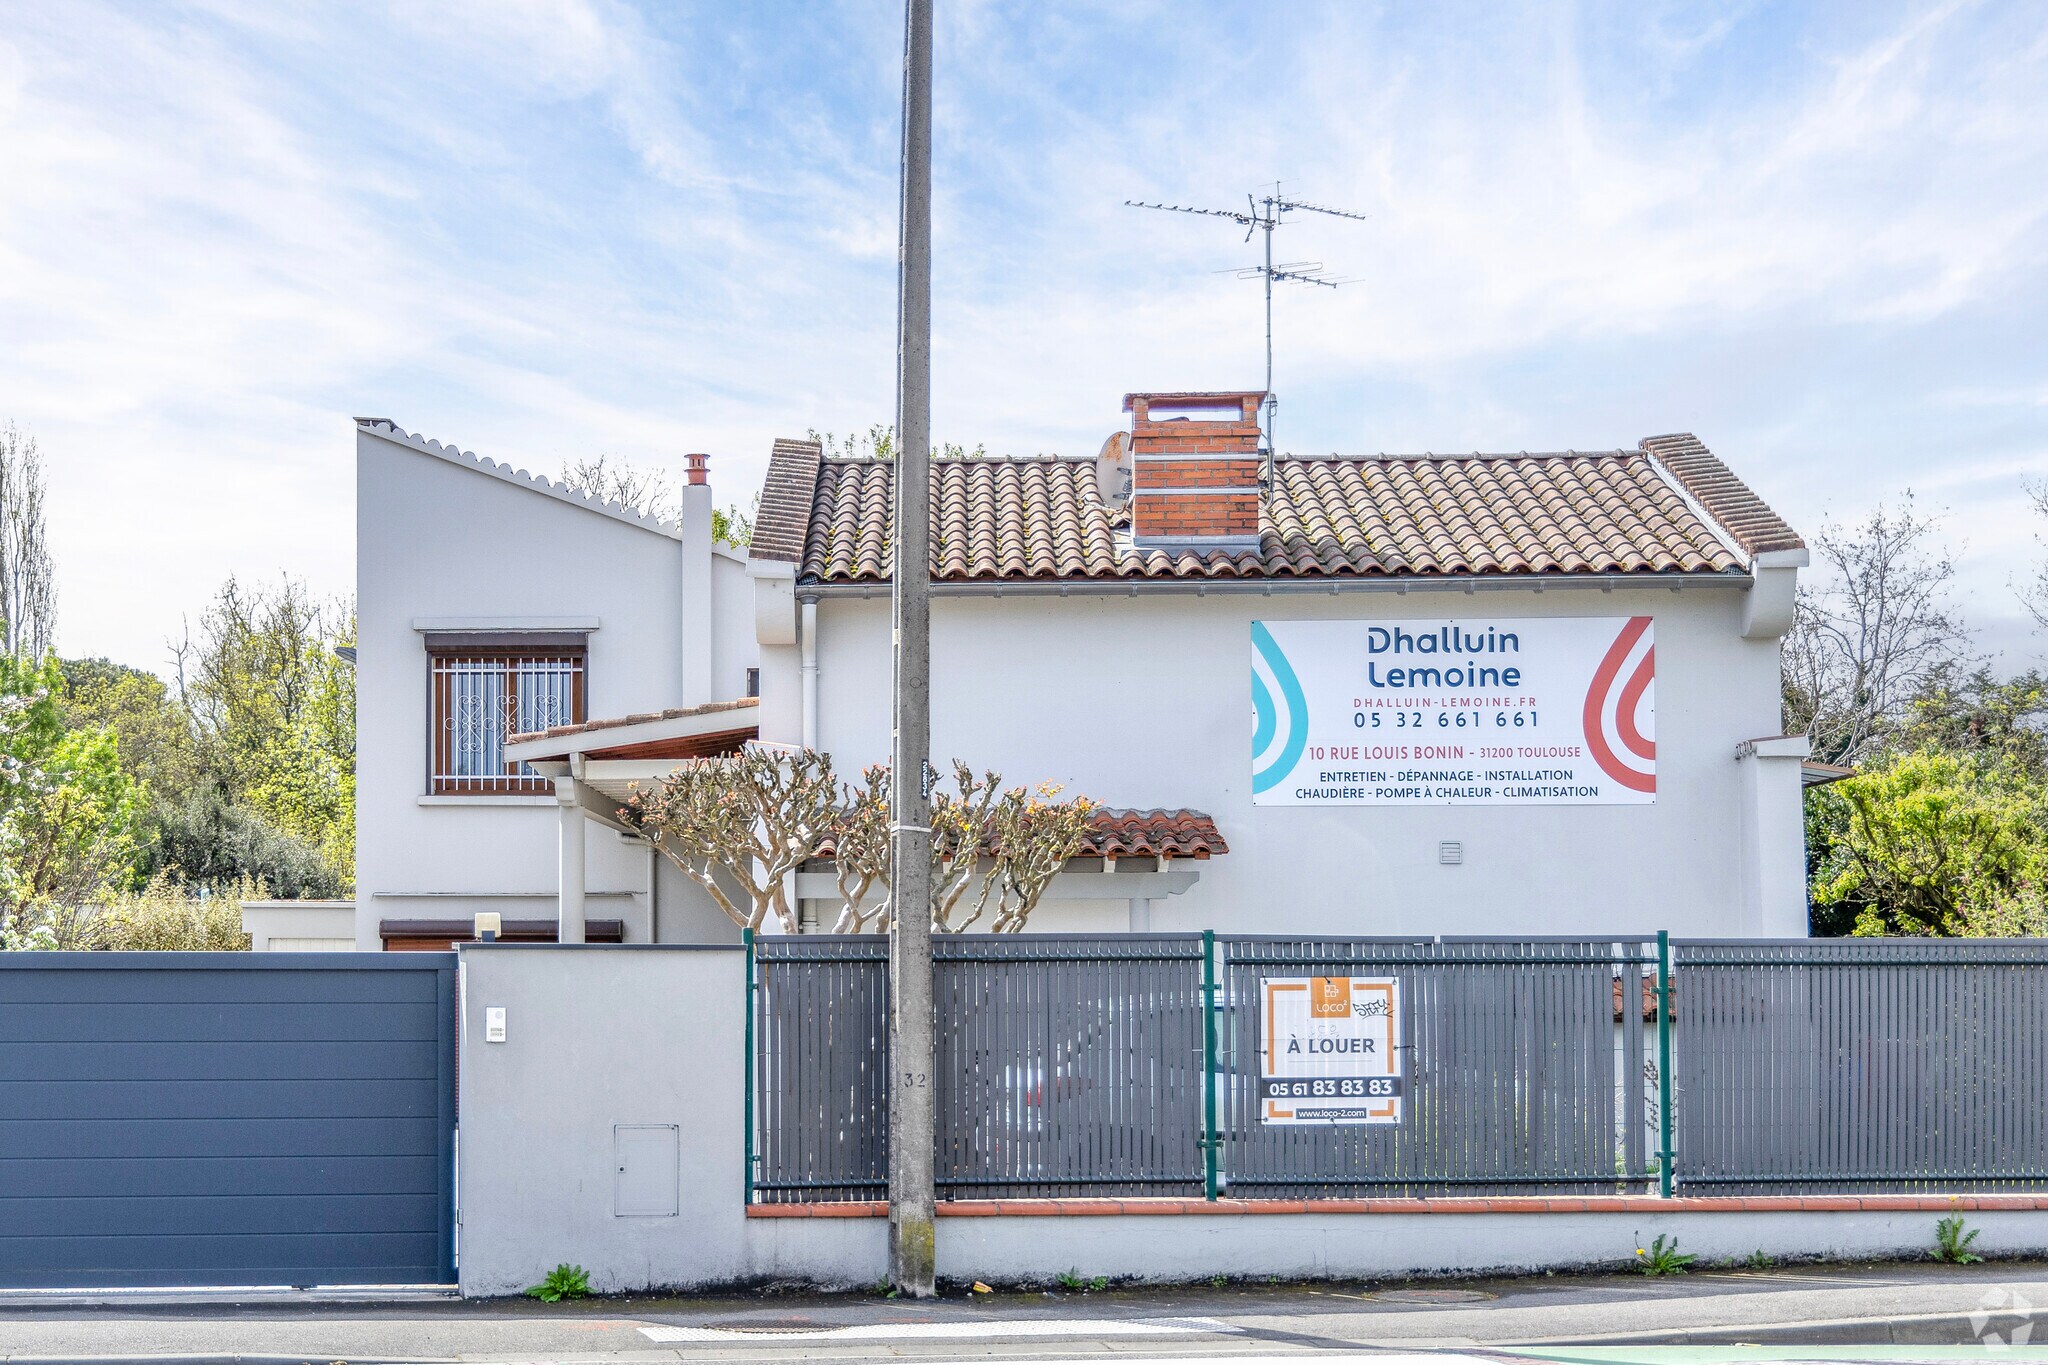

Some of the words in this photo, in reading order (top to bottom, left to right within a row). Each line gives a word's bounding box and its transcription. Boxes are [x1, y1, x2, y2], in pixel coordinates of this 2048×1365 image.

[1367, 626, 1519, 654] Dhalluin
[1368, 660, 1521, 688] Lemoine
[1353, 697, 1537, 708] DHALLUIN-LEMOINE.FR
[1353, 711, 1381, 728] 05
[1396, 711, 1423, 728] 32
[1437, 711, 1479, 728] 661
[1495, 710, 1537, 727] 661
[1309, 746, 1325, 761] 10
[1330, 746, 1359, 760] RUE
[1364, 746, 1409, 760] LOUIS
[1413, 745, 1464, 760] BONIN
[1480, 747, 1514, 759] 31200
[1516, 746, 1581, 758] TOULOUSE
[1319, 771, 1387, 783] ENTRETIEN
[1397, 768, 1474, 782] DÉPANNAGE
[1484, 769, 1573, 782] INSTALLATION
[1295, 785, 1365, 799] CHAUDIÈRE
[1375, 787, 1421, 799] POMPE
[1424, 784, 1433, 799] À
[1435, 786, 1492, 799] CHALEUR
[1502, 786, 1599, 798] CLIMATISATION
[1287, 1033, 1301, 1054] À
[1308, 1038, 1376, 1054] LOUER
[904, 1073, 925, 1088] 32
[1269, 1083, 1289, 1096] 05
[1292, 1083, 1308, 1096] 61
[1312, 1080, 1336, 1095] 83
[1340, 1079, 1364, 1095] 83
[1368, 1079, 1392, 1095] 83
[1298, 1109, 1365, 1118] www.loco-2.com
